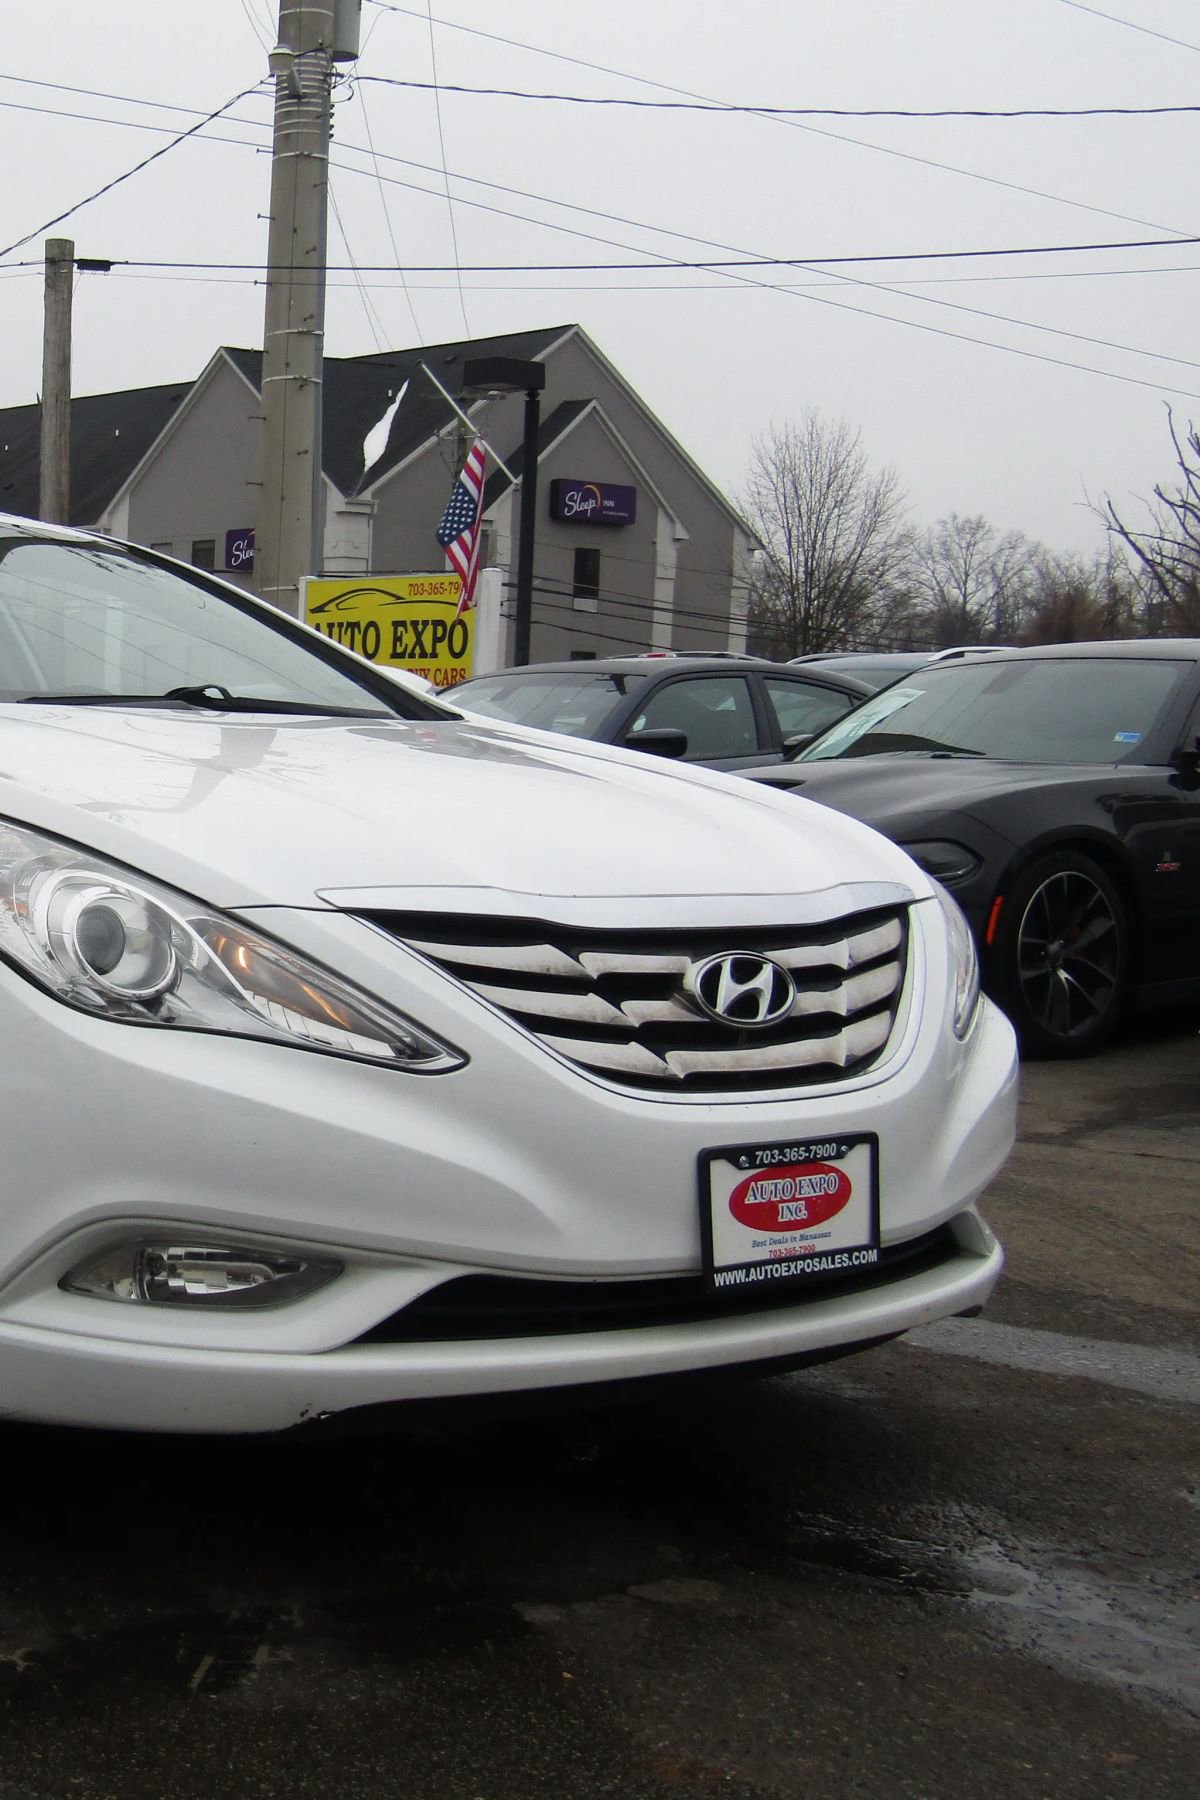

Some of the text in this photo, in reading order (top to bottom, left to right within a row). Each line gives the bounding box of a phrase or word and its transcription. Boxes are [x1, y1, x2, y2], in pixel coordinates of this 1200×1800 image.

[564, 491, 597, 517] Sleep
[231, 539, 254, 566] Slee
[390, 618, 469, 660] EXPO
[433, 667, 466, 686] CARS
[755, 1143, 837, 1165] 703-365-7900
[745, 1174, 839, 1203] AUTO EXPO
[777, 1202, 807, 1221] INC.
[752, 1239, 767, 1248] Best
[768, 1236, 788, 1246] Deals
[714, 1249, 878, 1287] WWW.AUTOEXPOSALES.COM
